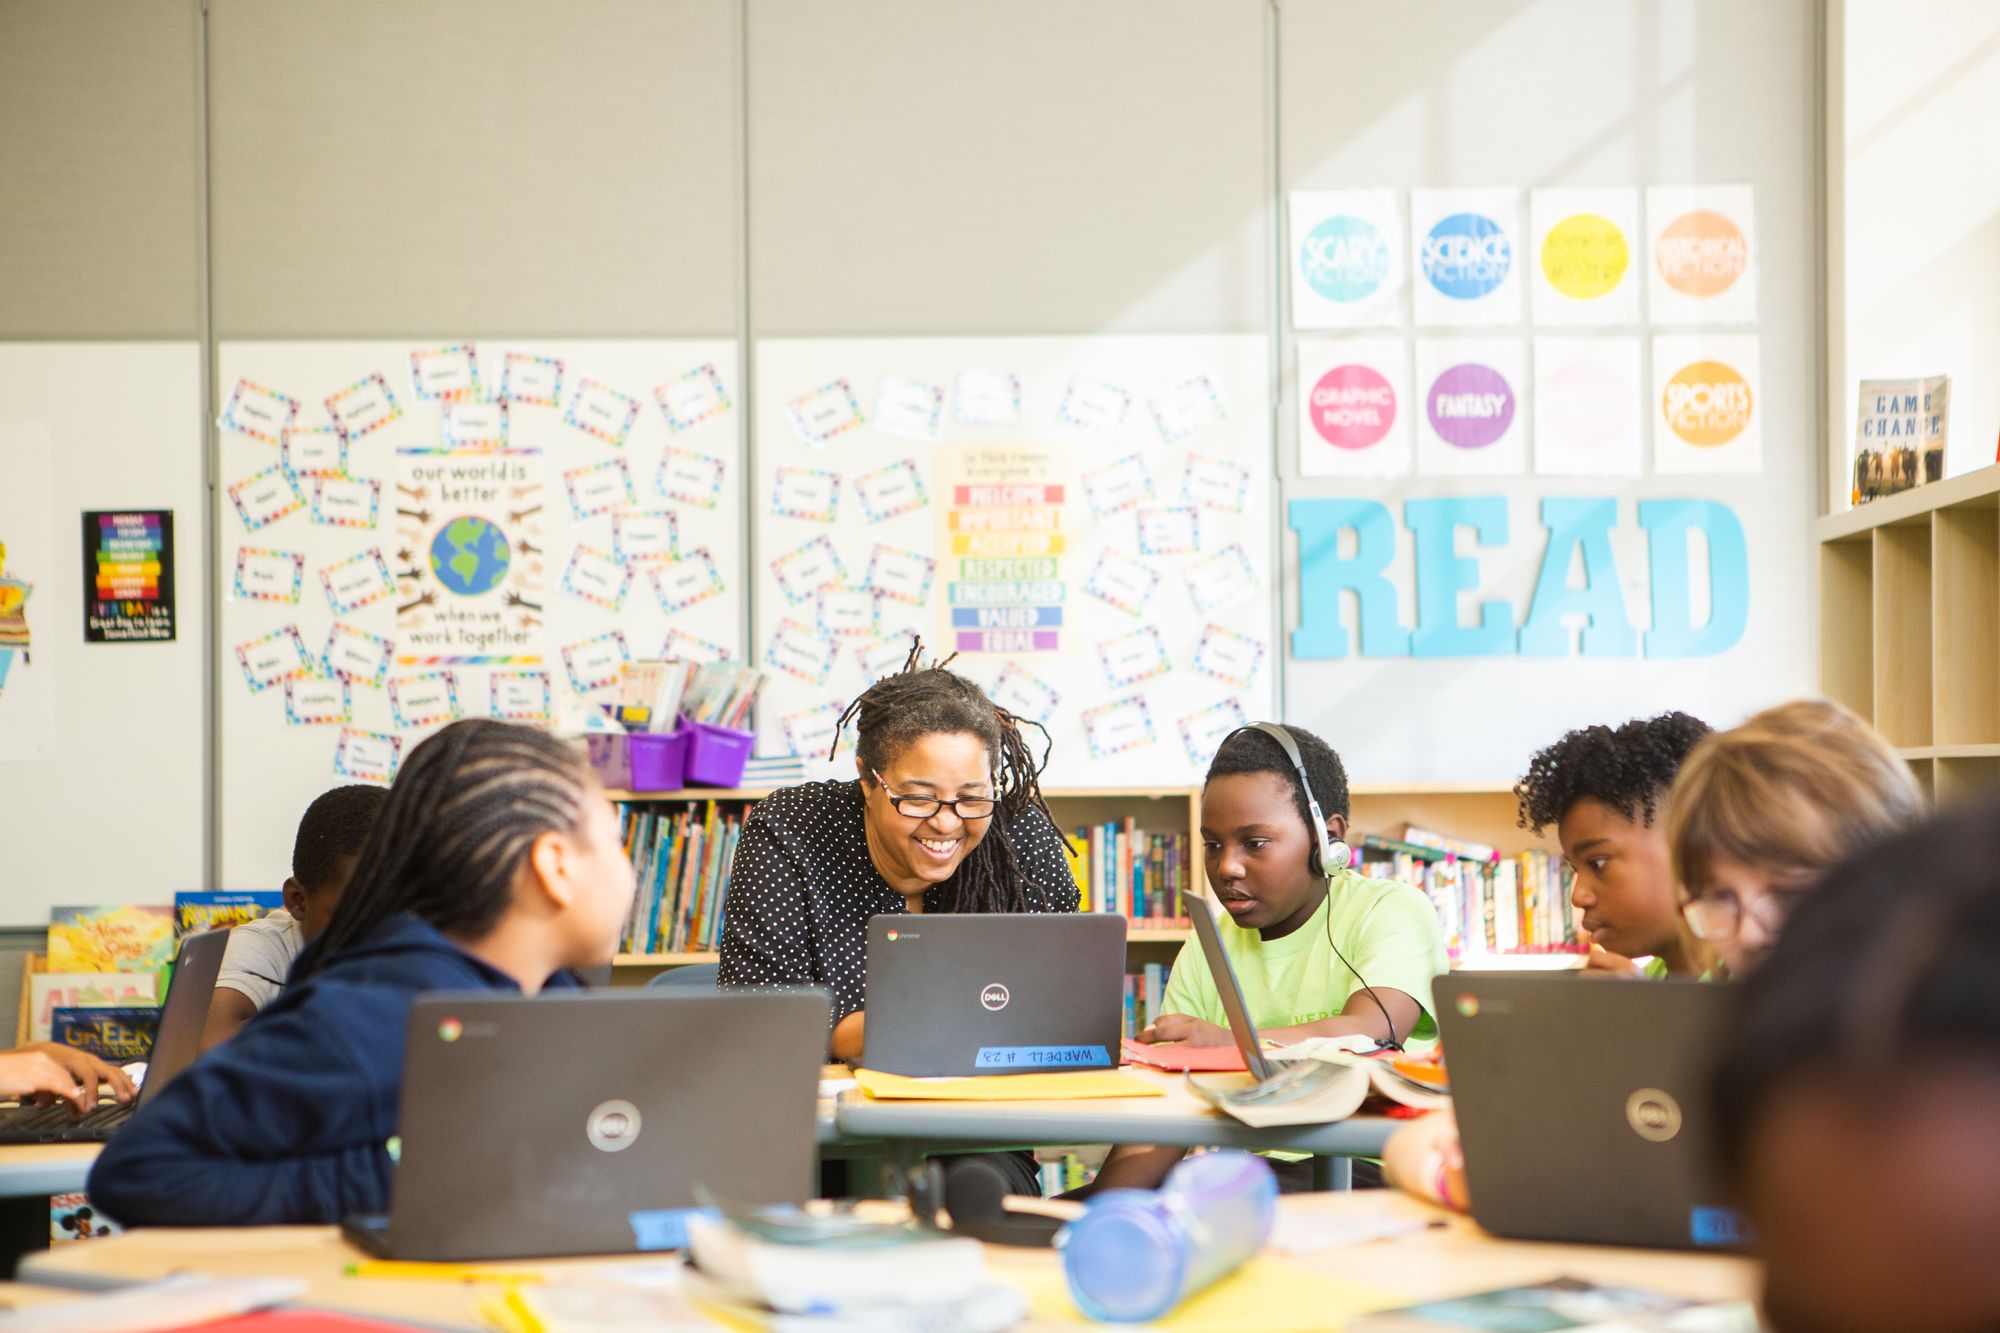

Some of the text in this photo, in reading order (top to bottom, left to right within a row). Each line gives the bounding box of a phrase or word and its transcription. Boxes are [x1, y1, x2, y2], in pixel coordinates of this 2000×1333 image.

[1305, 236, 1388, 268] SCARY
[1422, 235, 1510, 267] SCIENCE
[1425, 260, 1509, 284] FICTION
[1312, 387, 1392, 407] GRAPHIC
[1436, 393, 1507, 419] FANTASY
[1665, 383, 1751, 413] SPORTS
[1876, 393, 1932, 414] GAME
[1323, 407, 1382, 428] NOVEL
[1671, 406, 1751, 431] FICTION
[411, 460, 529, 483] our world is
[440, 482, 500, 502] better
[964, 557, 1055, 580] RESPECTED
[1287, 496, 1750, 660] READ
[955, 581, 1064, 605] ENCOURAGED
[433, 604, 502, 623] when we
[977, 606, 1039, 629] VALUED
[408, 625, 532, 651] work together
[982, 630, 1036, 652] EQUAL
[984, 992, 1007, 1001] DELL
[1006, 1052, 1016, 1062] #
[1027, 1049, 1093, 1063] WARDELL
